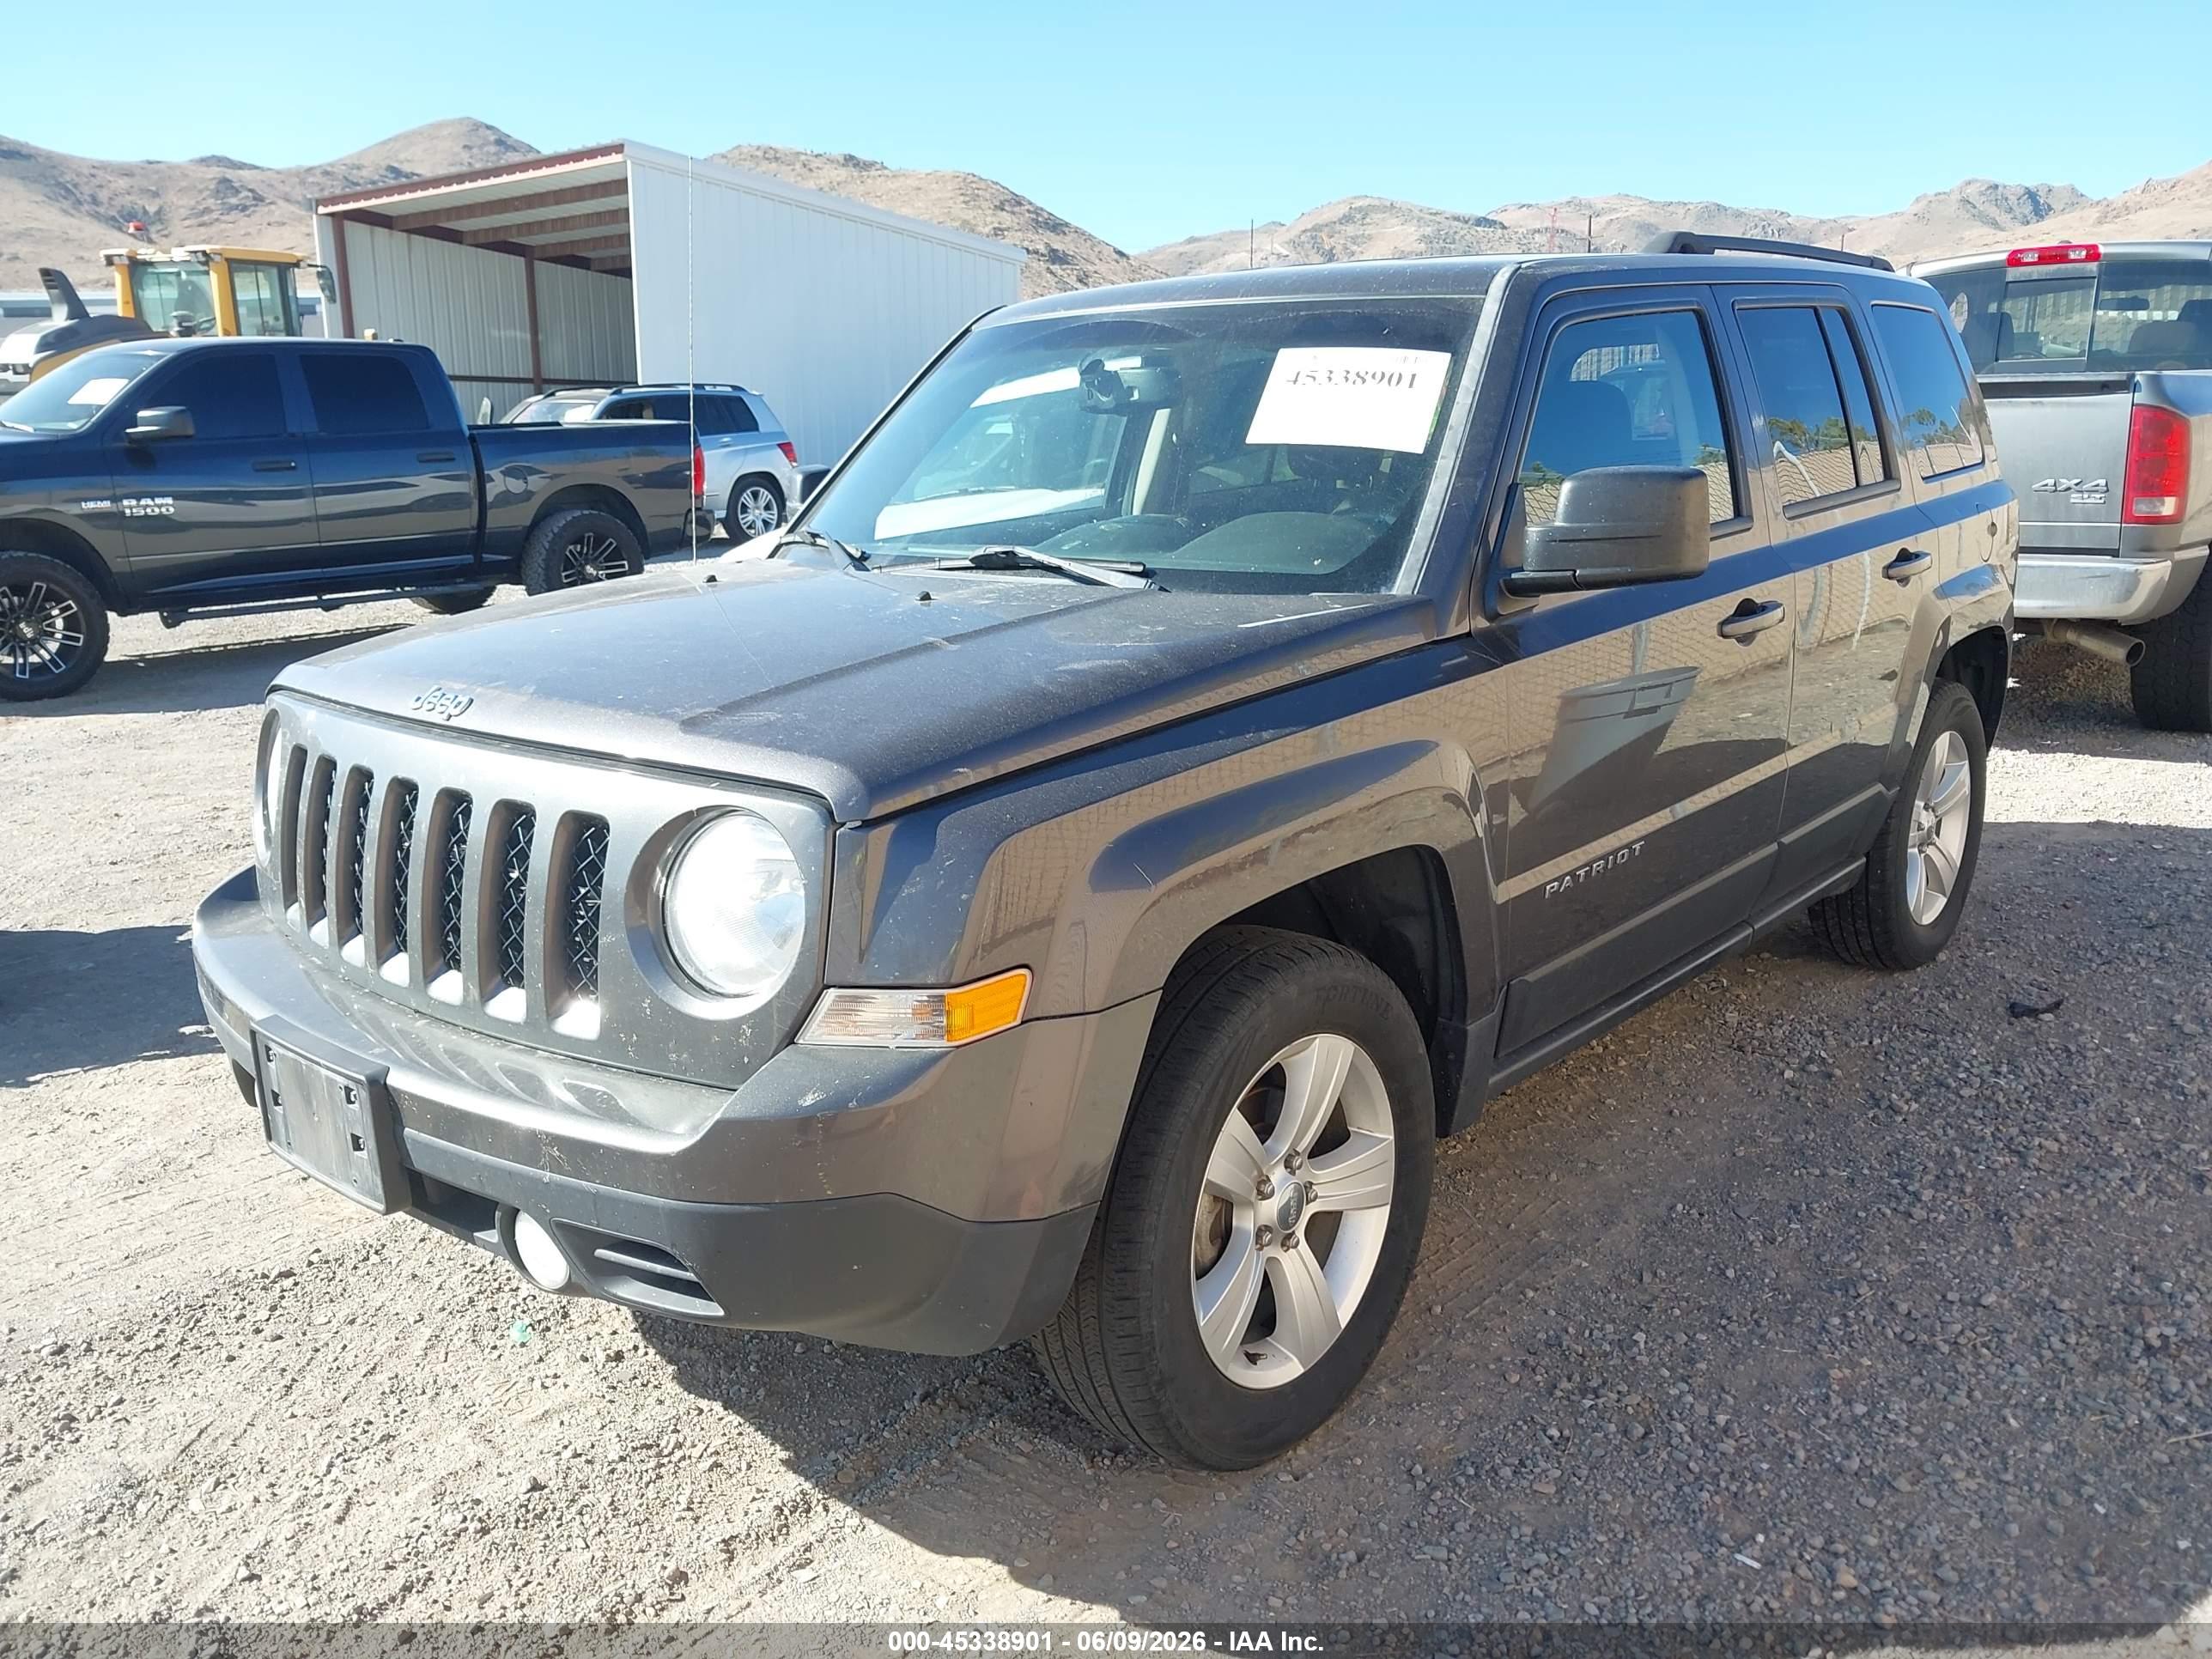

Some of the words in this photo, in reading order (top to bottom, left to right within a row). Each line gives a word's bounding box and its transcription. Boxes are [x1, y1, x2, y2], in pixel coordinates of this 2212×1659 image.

[1285, 369, 1417, 389] 45338901
[2032, 478, 2109, 493] 4X4
[122, 496, 173, 507] RAM
[124, 506, 175, 517] 1500
[411, 686, 474, 721] Jeep
[1544, 841, 1645, 899] PATRIOT
